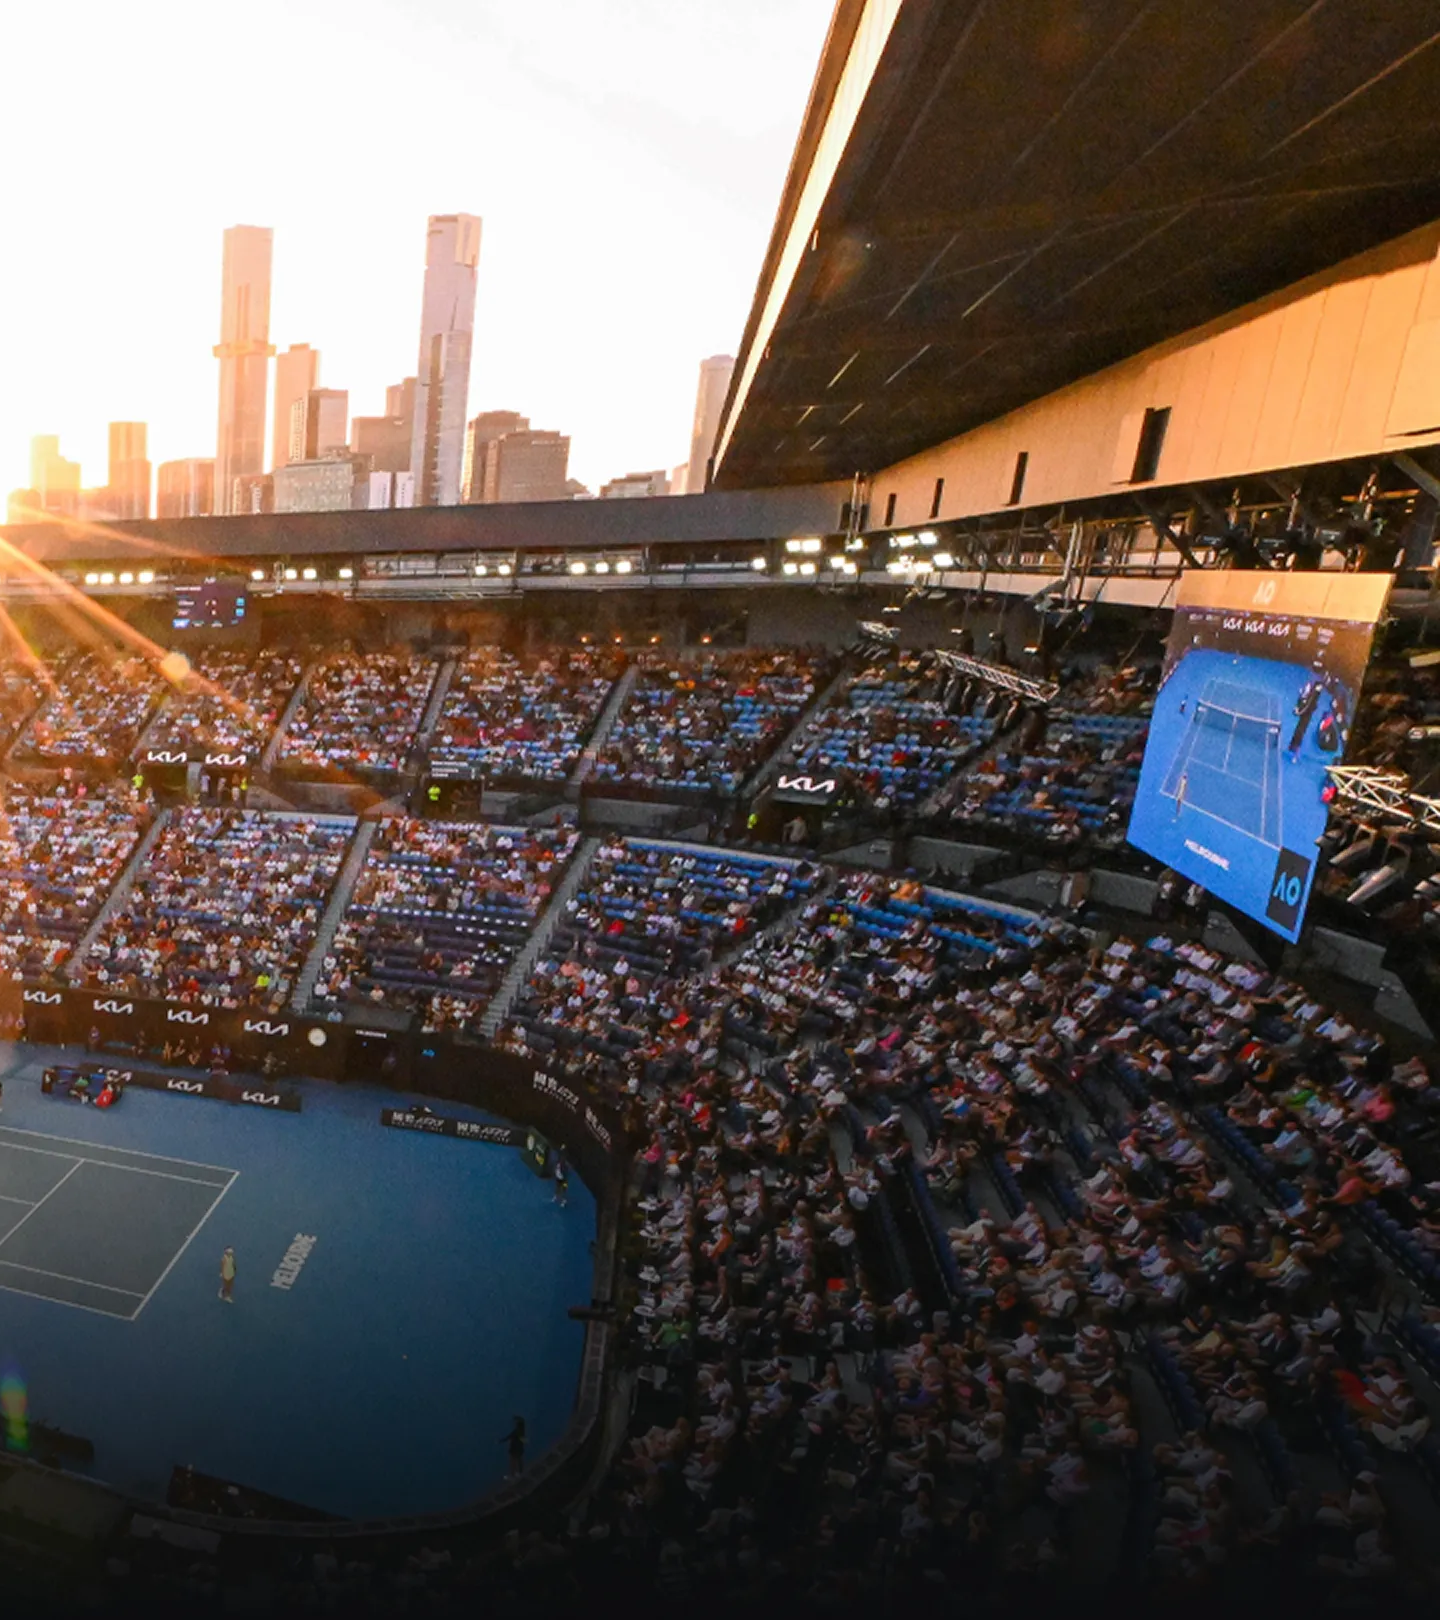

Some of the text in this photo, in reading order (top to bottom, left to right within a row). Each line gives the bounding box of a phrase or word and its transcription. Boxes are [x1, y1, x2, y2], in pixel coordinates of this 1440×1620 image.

[147, 751, 187, 763] KIA
[205, 752, 247, 766] KIA
[777, 775, 835, 793] KIA
[23, 990, 62, 1005] KIA
[93, 999, 134, 1014] KIA
[167, 1009, 209, 1025] KIA
[243, 1019, 289, 1036] KIA
[167, 1078, 203, 1092] KIA
[242, 1091, 280, 1105] KIA
